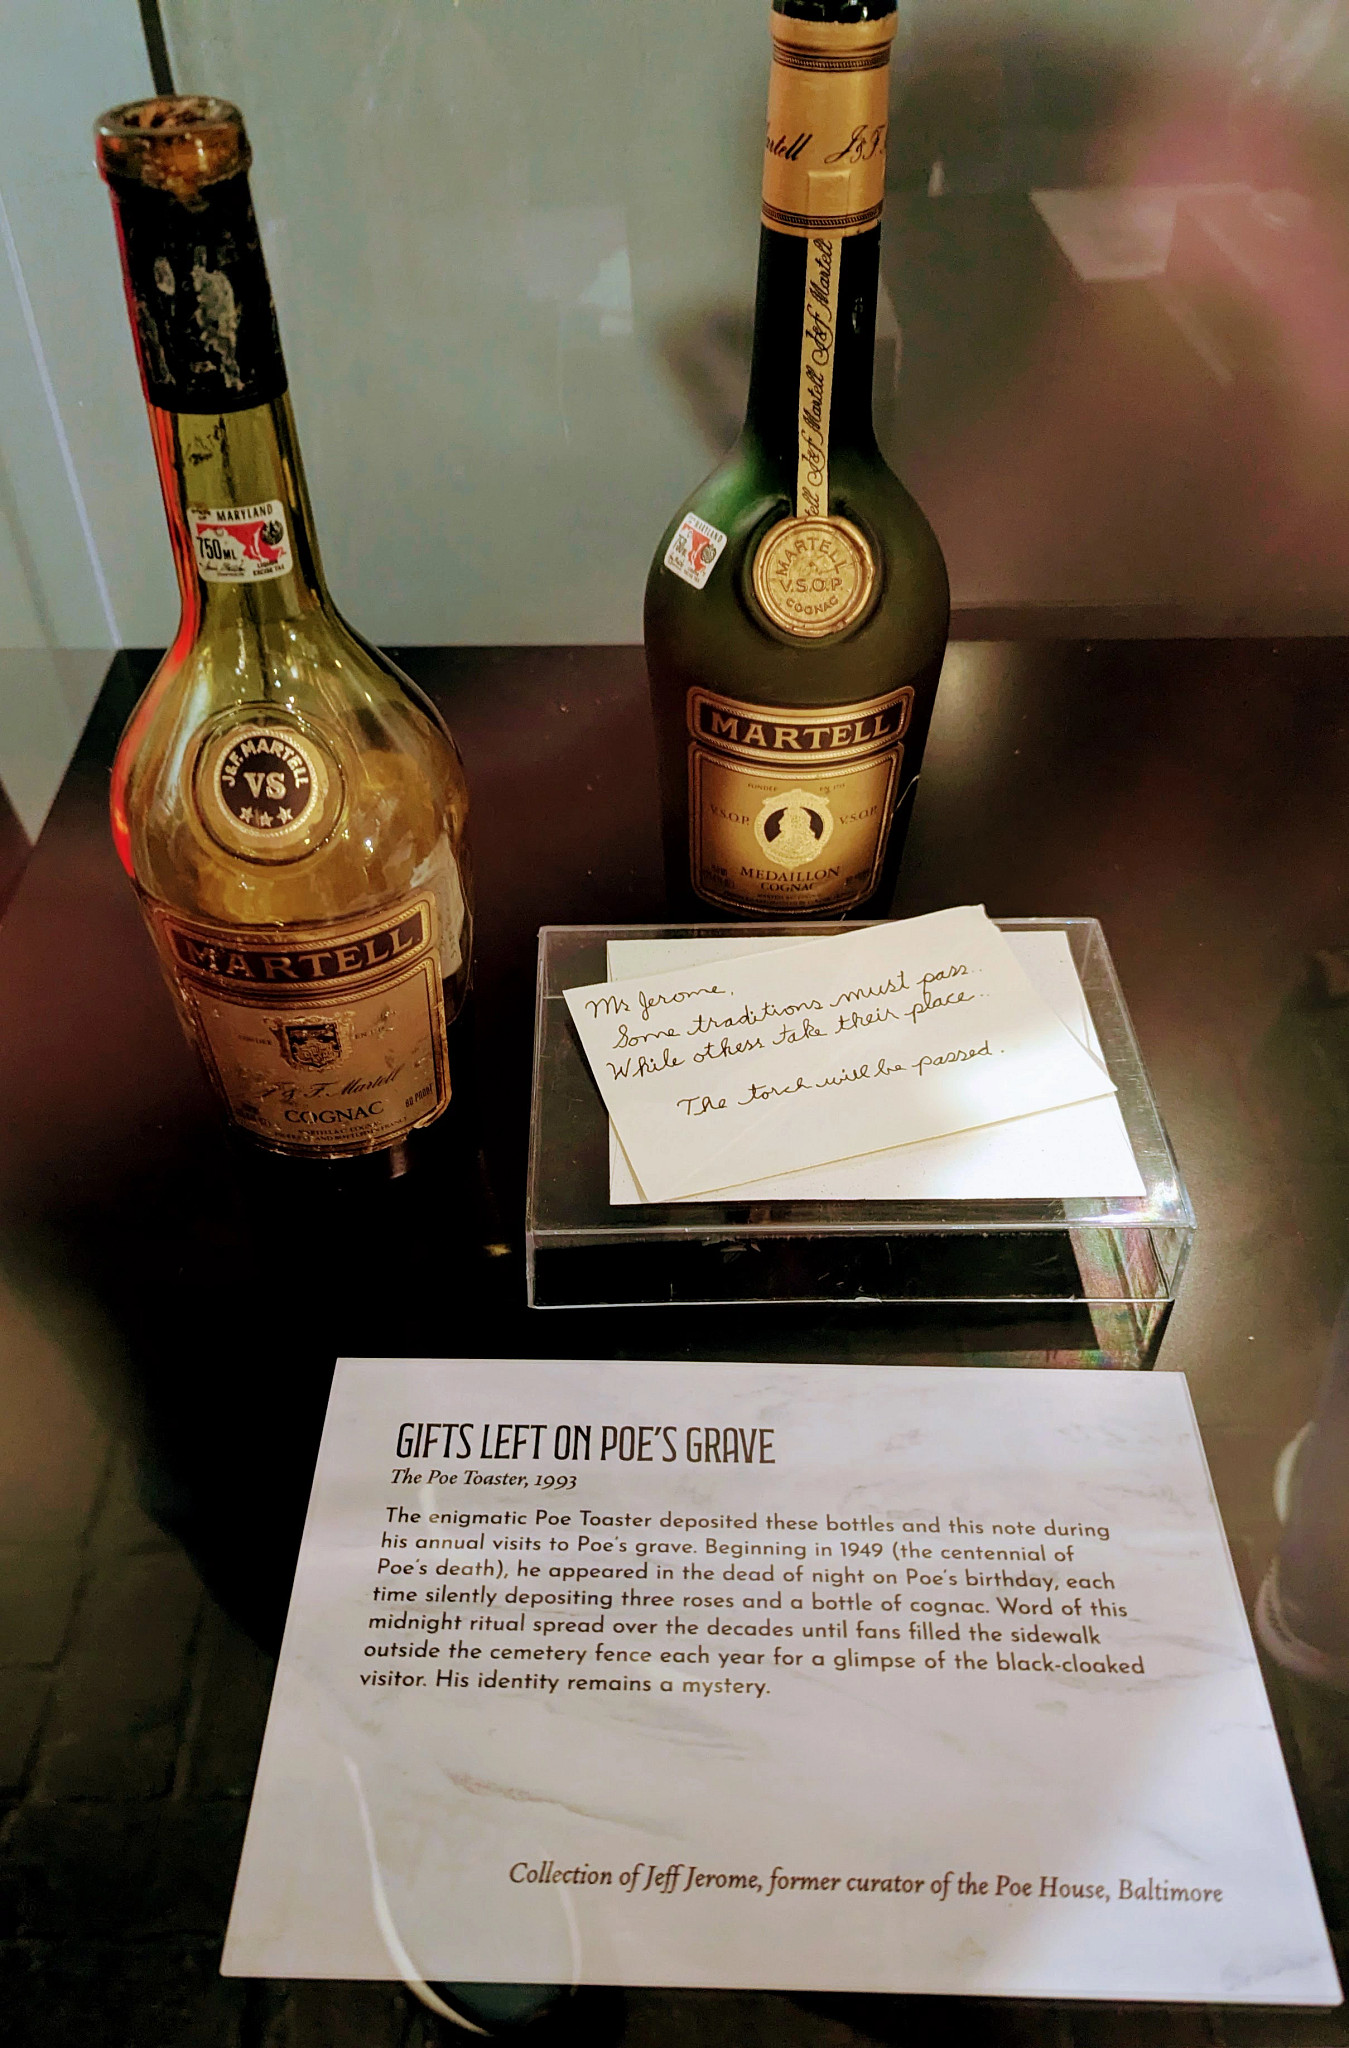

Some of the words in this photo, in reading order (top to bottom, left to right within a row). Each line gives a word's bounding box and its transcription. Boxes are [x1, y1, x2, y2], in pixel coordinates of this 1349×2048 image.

[809, 237, 833, 322] Martell
[216, 504, 273, 520] MARYLAND
[802, 486, 820, 517] tell
[776, 537, 847, 576] MARTELL
[786, 595, 838, 615] COGNAC
[711, 711, 890, 749] MARTELL
[243, 738, 310, 789] MARTELL
[244, 772, 287, 799] VS
[740, 865, 841, 882] MEDAILLON
[184, 930, 413, 979] MARTELL
[612, 1024, 681, 1049] Some
[687, 1000, 823, 1035] traditions
[830, 970, 910, 1012] must
[606, 1048, 685, 1080] While
[772, 1018, 828, 1045] take
[835, 1008, 900, 1034] their
[677, 1096, 727, 1116] The
[738, 1077, 812, 1105] torch
[816, 1065, 870, 1088] will
[874, 1059, 907, 1077] be
[284, 1101, 384, 1124] COGNAC
[395, 1422, 475, 1460] GIFTS
[479, 1423, 548, 1460] LEFT
[553, 1424, 592, 1461] ON
[685, 1426, 776, 1465] GRAVE
[390, 1466, 423, 1485] The
[425, 1469, 459, 1485] Poe
[462, 1469, 529, 1489] Toaster,
[533, 1474, 578, 1491] 1993
[385, 1505, 422, 1524] The
[428, 1509, 528, 1529] enigmatic
[535, 1508, 572, 1527] Poe
[578, 1509, 653, 1528] Toaster
[659, 1510, 758, 1533] deposited
[765, 1512, 819, 1531] these
[825, 1513, 895, 1533] bottles
[901, 1515, 941, 1534] and
[948, 1516, 985, 1535] this
[991, 1521, 1037, 1536] note
[1043, 1518, 1110, 1542] during
[380, 1530, 408, 1549] his
[414, 1532, 486, 1551] annual
[491, 1535, 542, 1552] visits
[548, 1536, 570, 1552] to
[634, 1542, 698, 1558] grave.
[705, 1537, 807, 1561] Beginning
[814, 1542, 833, 1557] in
[839, 1541, 884, 1558] 1949
[892, 1540, 933, 1562] (the
[940, 1543, 1047, 1562] centennial
[1053, 1544, 1075, 1563] of
[434, 1557, 509, 1580] death),
[516, 1558, 542, 1578] he
[548, 1557, 652, 1583] appeared
[656, 1564, 675, 1580] in
[681, 1561, 716, 1581] the
[722, 1562, 775, 1582] dead
[782, 1564, 805, 1583] of
[812, 1565, 866, 1588] night
[872, 1573, 898, 1585] on
[964, 1567, 1060, 1593] birthday,
[1065, 1570, 1116, 1590] each
[372, 1585, 419, 1607] time
[424, 1583, 502, 1610] silently
[504, 1585, 613, 1613] depositing
[620, 1587, 676, 1607] three
[682, 1596, 735, 1609] roses
[742, 1590, 782, 1610] and
[790, 1598, 804, 1610] a
[811, 1591, 873, 1612] bottle
[880, 1593, 903, 1613] of
[909, 1600, 990, 1618] cognac.
[995, 1596, 1054, 1616] Word
[1060, 1597, 1083, 1617] of
[1089, 1597, 1128, 1618] this
[367, 1611, 462, 1633] midnight
[469, 1612, 526, 1632] ritual
[532, 1613, 605, 1637] spread
[612, 1622, 659, 1635] over
[665, 1615, 700, 1636] the
[706, 1616, 794, 1638] decades
[801, 1618, 848, 1639] until
[855, 1619, 902, 1640] fans
[907, 1620, 961, 1642] filled
[968, 1621, 1003, 1643] the
[1010, 1623, 1102, 1645] sidewalk
[363, 1638, 441, 1659] outside
[447, 1639, 483, 1660] the
[489, 1644, 588, 1666] cemetery
[594, 1641, 653, 1663] fence
[659, 1643, 710, 1664] each
[717, 1652, 766, 1669] year
[772, 1645, 804, 1666] for
[811, 1654, 825, 1667] a
[833, 1647, 917, 1673] glimpse
[924, 1649, 947, 1670] of
[953, 1649, 989, 1671] the
[995, 1650, 1146, 1675] black-cloaked
[359, 1669, 427, 1688] visitor.
[435, 1668, 470, 1688] His
[477, 1668, 560, 1695] identity
[567, 1674, 652, 1693] remains
[659, 1680, 674, 1693] a
[682, 1677, 771, 1699] mystery.
[508, 1860, 613, 1886] Collection
[618, 1862, 646, 1894] of
[641, 1863, 686, 1895] Jeff
[682, 1865, 764, 1894] Jerome,
[765, 1865, 843, 1898] former
[845, 1874, 926, 1894] curator
[929, 1870, 956, 1902] of
[956, 1871, 989, 1896] the
[994, 1874, 1033, 1898] Poe
[1037, 1875, 1111, 1904] House,
[1117, 1876, 1224, 1903] Baltimore
